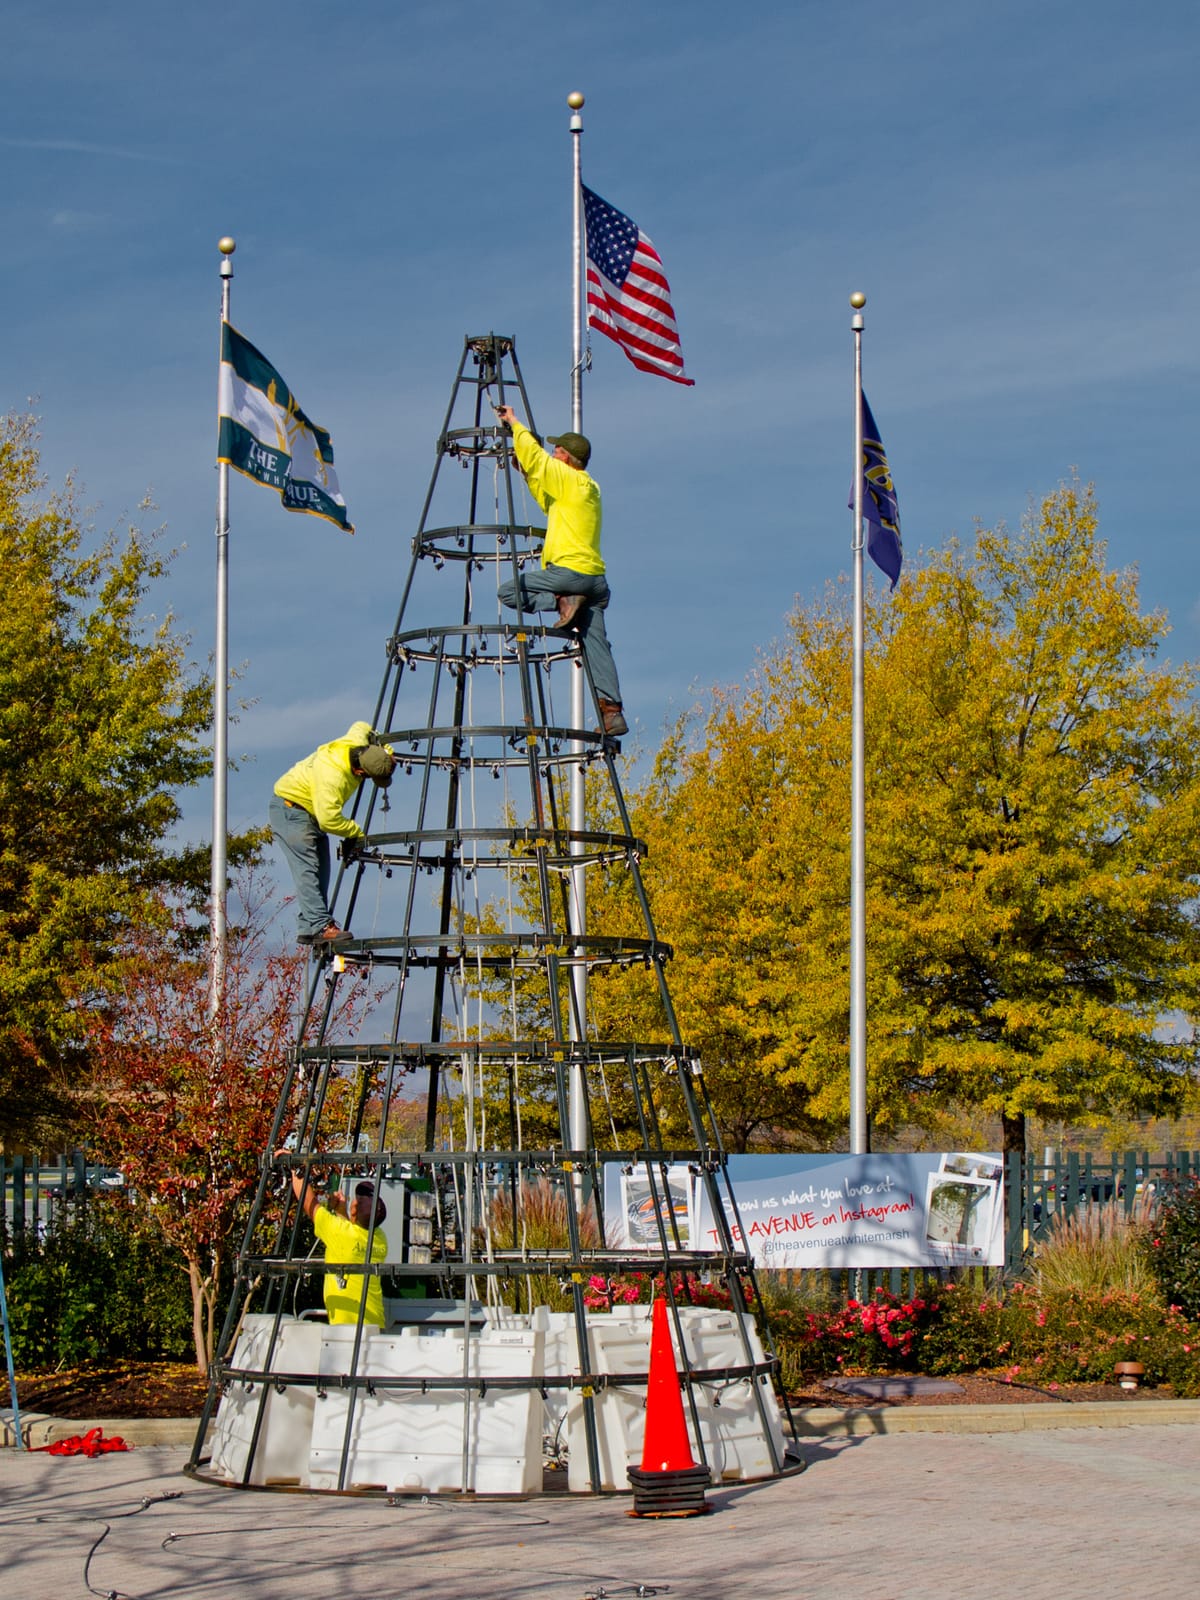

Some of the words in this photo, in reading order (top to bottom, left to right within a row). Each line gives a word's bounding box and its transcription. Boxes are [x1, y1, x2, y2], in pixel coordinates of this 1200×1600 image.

[250, 438, 278, 472] THE
[721, 1197, 758, 1213] Sow
[762, 1198, 779, 1208] us
[782, 1185, 818, 1206] what
[819, 1187, 843, 1208] you
[844, 1177, 874, 1197] love
[876, 1176, 895, 1192] at
[707, 1224, 743, 1244] TE
[748, 1212, 820, 1237] AVENUE
[822, 1216, 837, 1227] on
[839, 1193, 915, 1223] Instagram!
[763, 1229, 910, 1254] @theavenueatwhitemarsh
